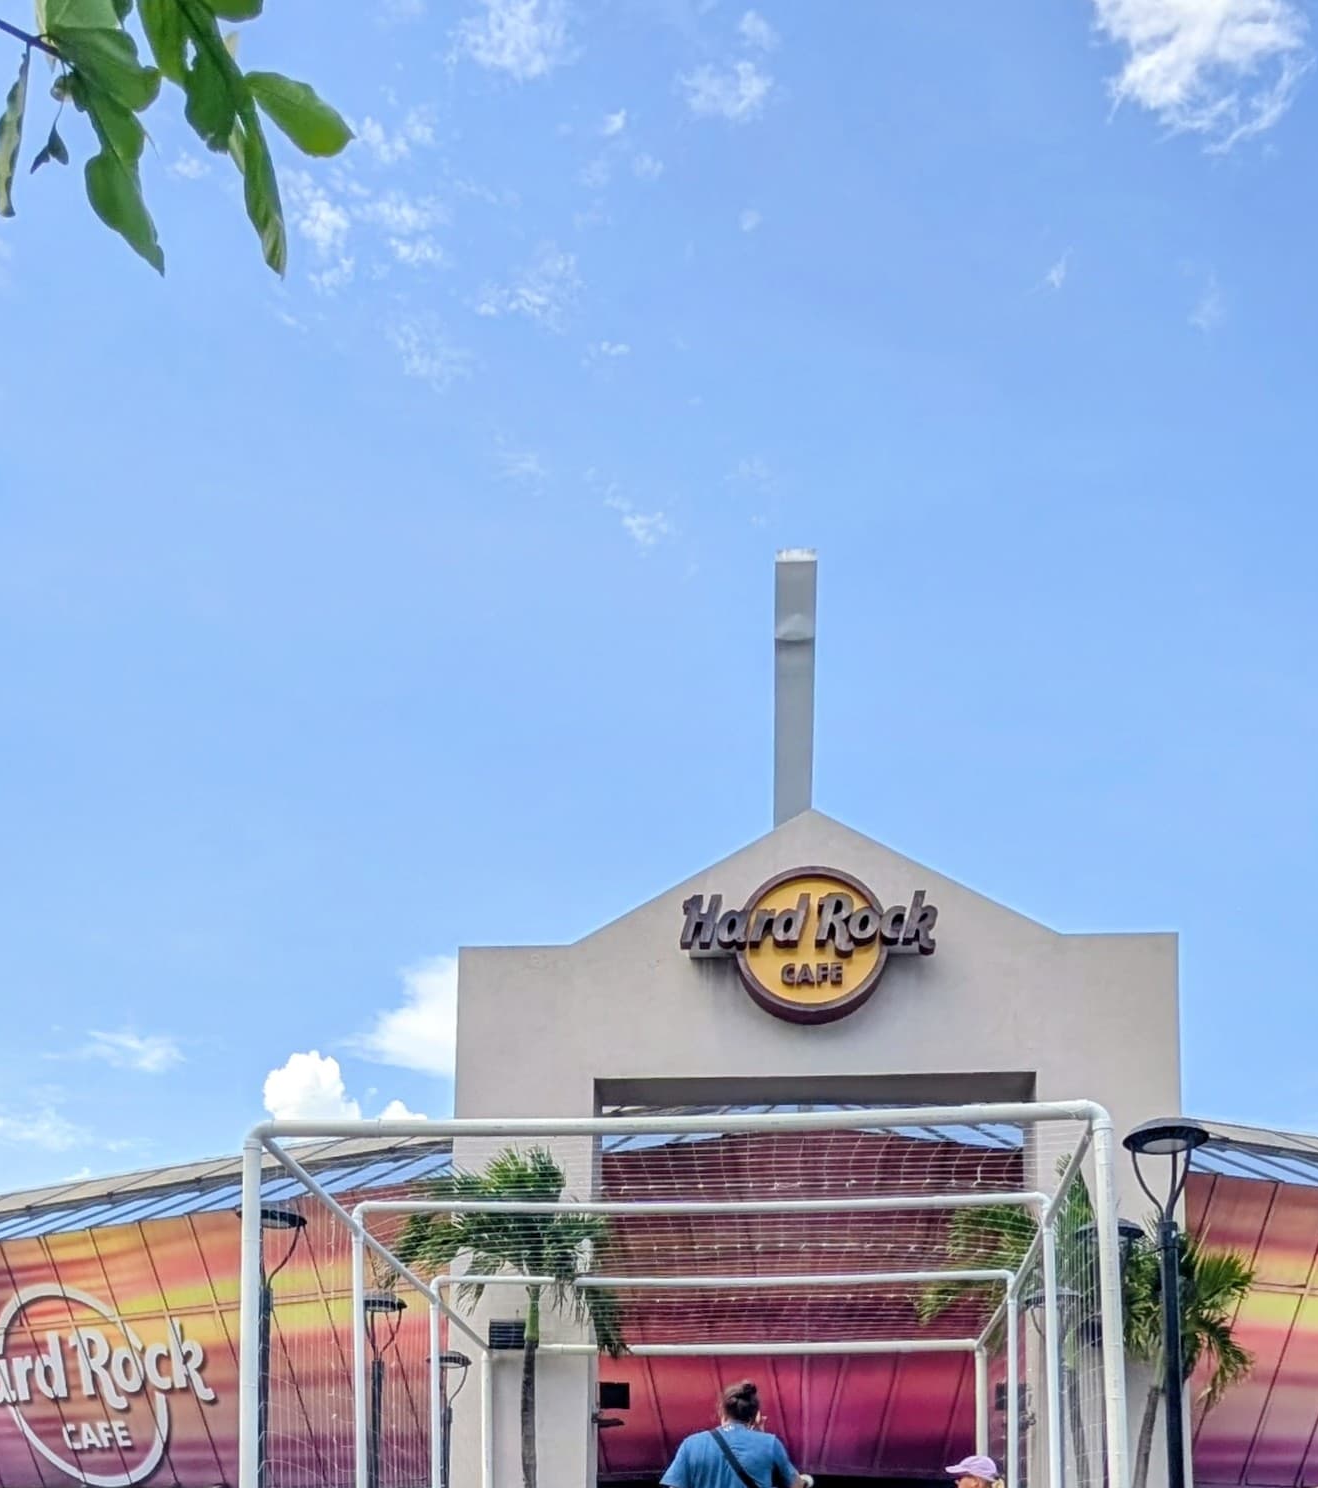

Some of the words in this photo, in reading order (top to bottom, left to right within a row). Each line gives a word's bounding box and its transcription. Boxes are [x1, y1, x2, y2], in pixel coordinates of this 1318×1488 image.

[680, 893, 811, 951] Hard
[815, 890, 938, 957] Rock
[781, 962, 843, 985] CAFE
[69, 1317, 215, 1409] Rock
[62, 1420, 132, 1450] CAFE
